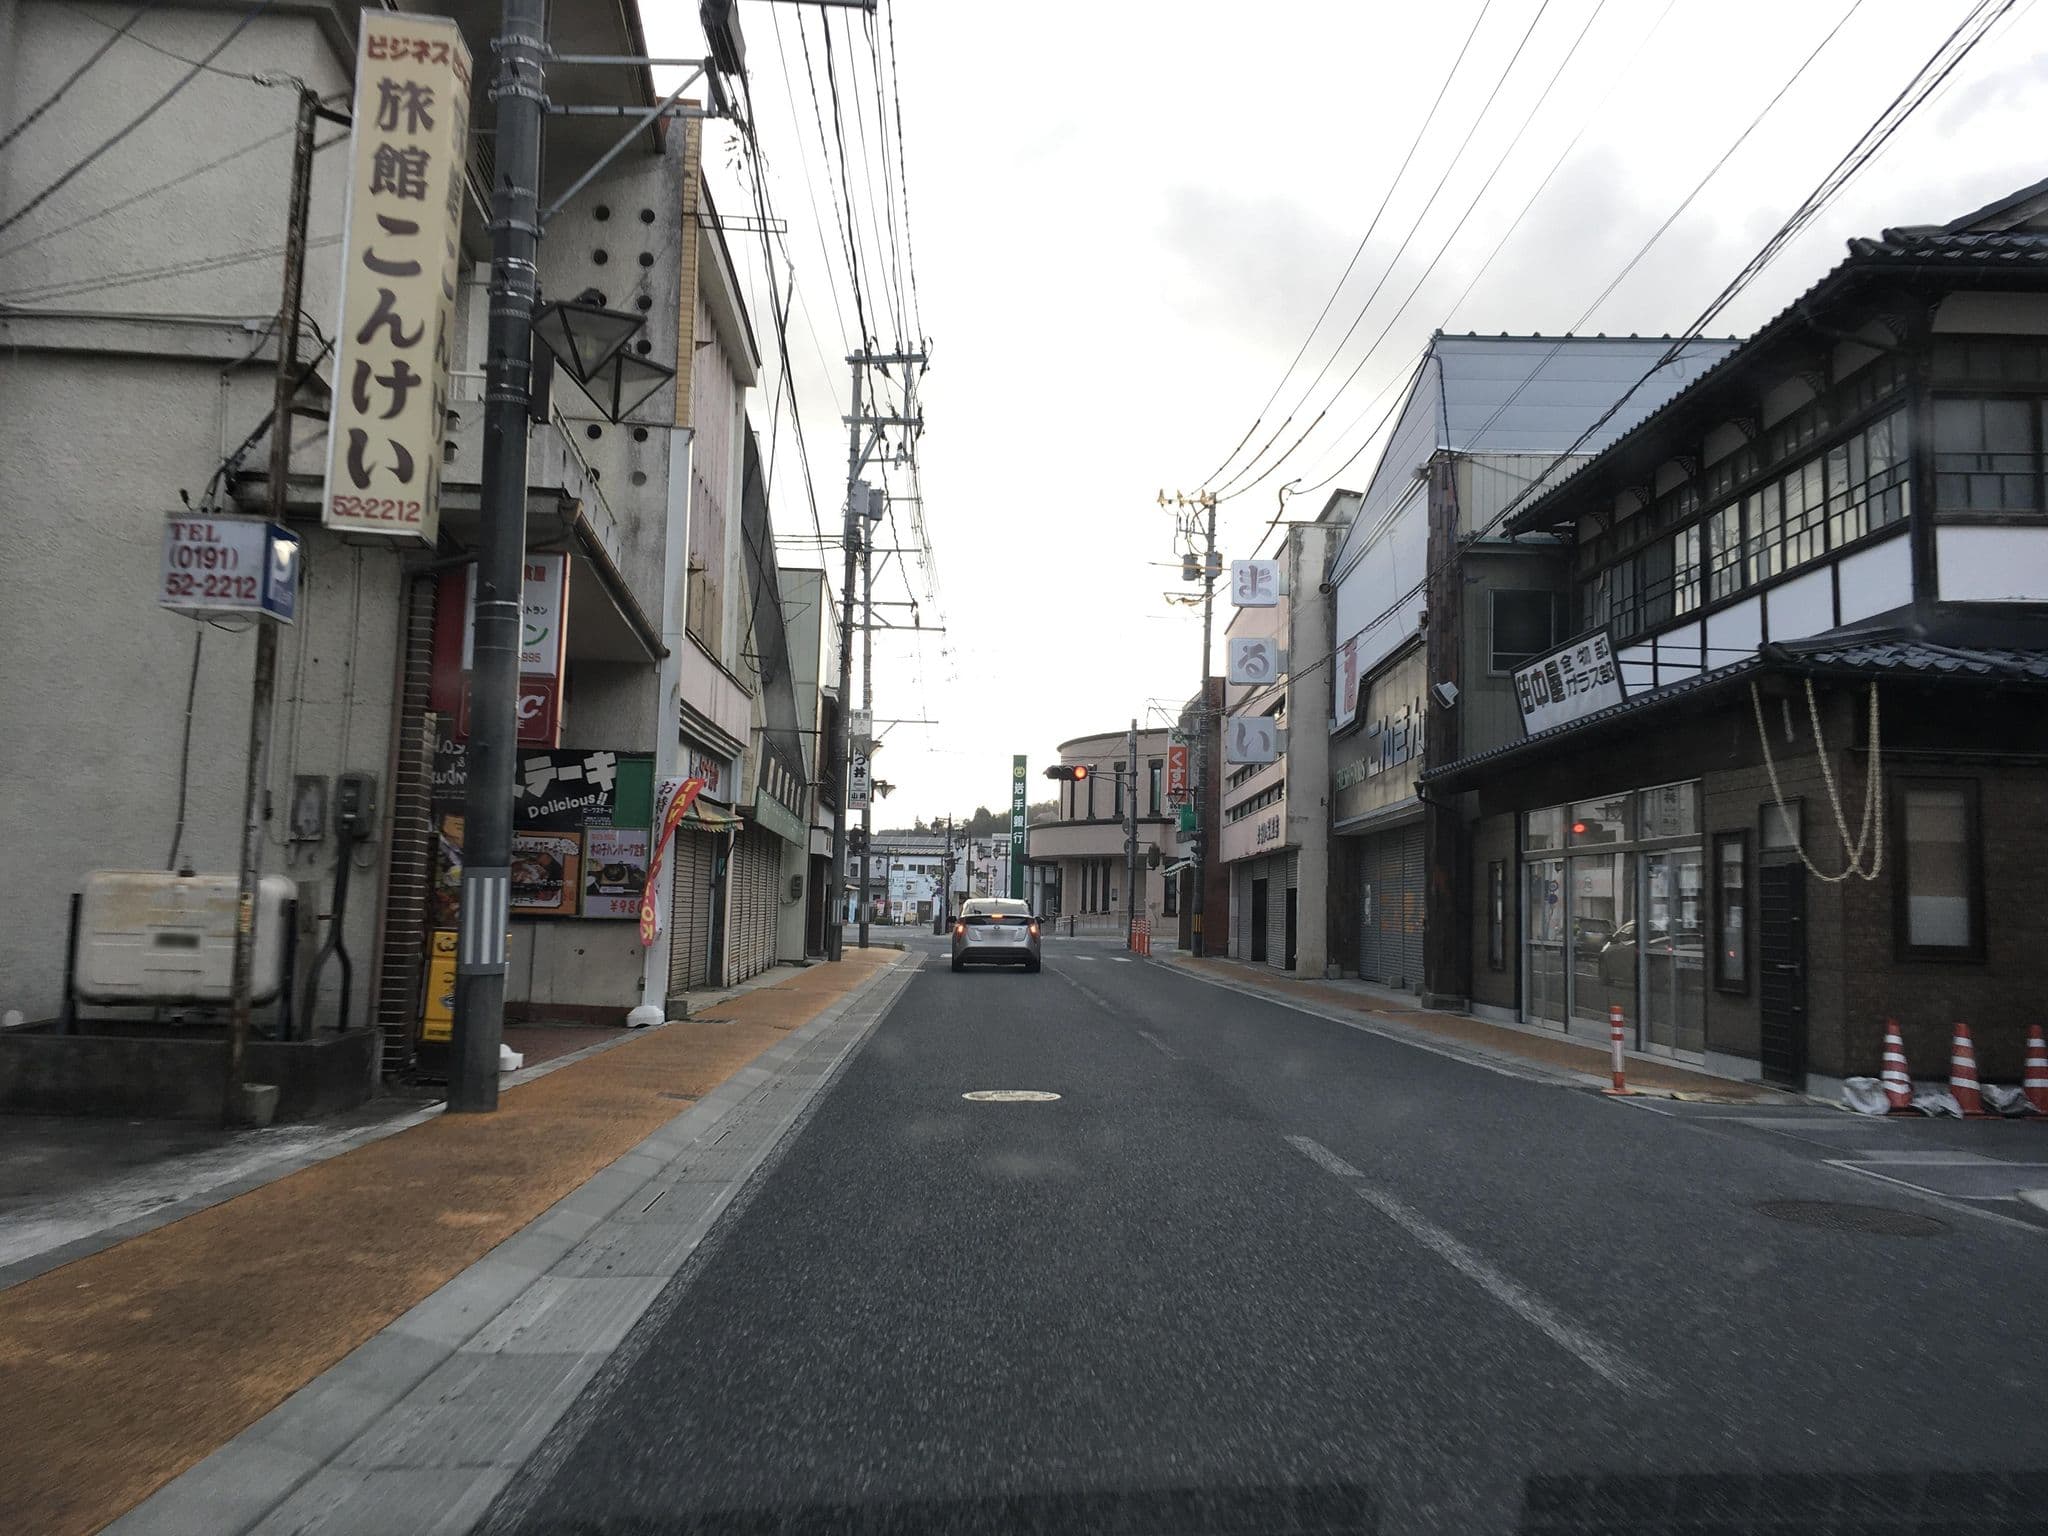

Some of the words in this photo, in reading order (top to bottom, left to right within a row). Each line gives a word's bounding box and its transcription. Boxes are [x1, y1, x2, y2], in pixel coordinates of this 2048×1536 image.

[368, 34, 450, 65] ビジネス
[346, 77, 435, 490] 旅館こんけい
[332, 495, 421, 523] 52-2212
[169, 522, 221, 543] TEL
[168, 544, 239, 571] (0191)
[166, 572, 257, 599] 52-2212
[1516, 660, 1567, 716] 田中屋
[1565, 661, 1616, 697] ガラス部
[1013, 782, 1025, 844] 岩手銀行
